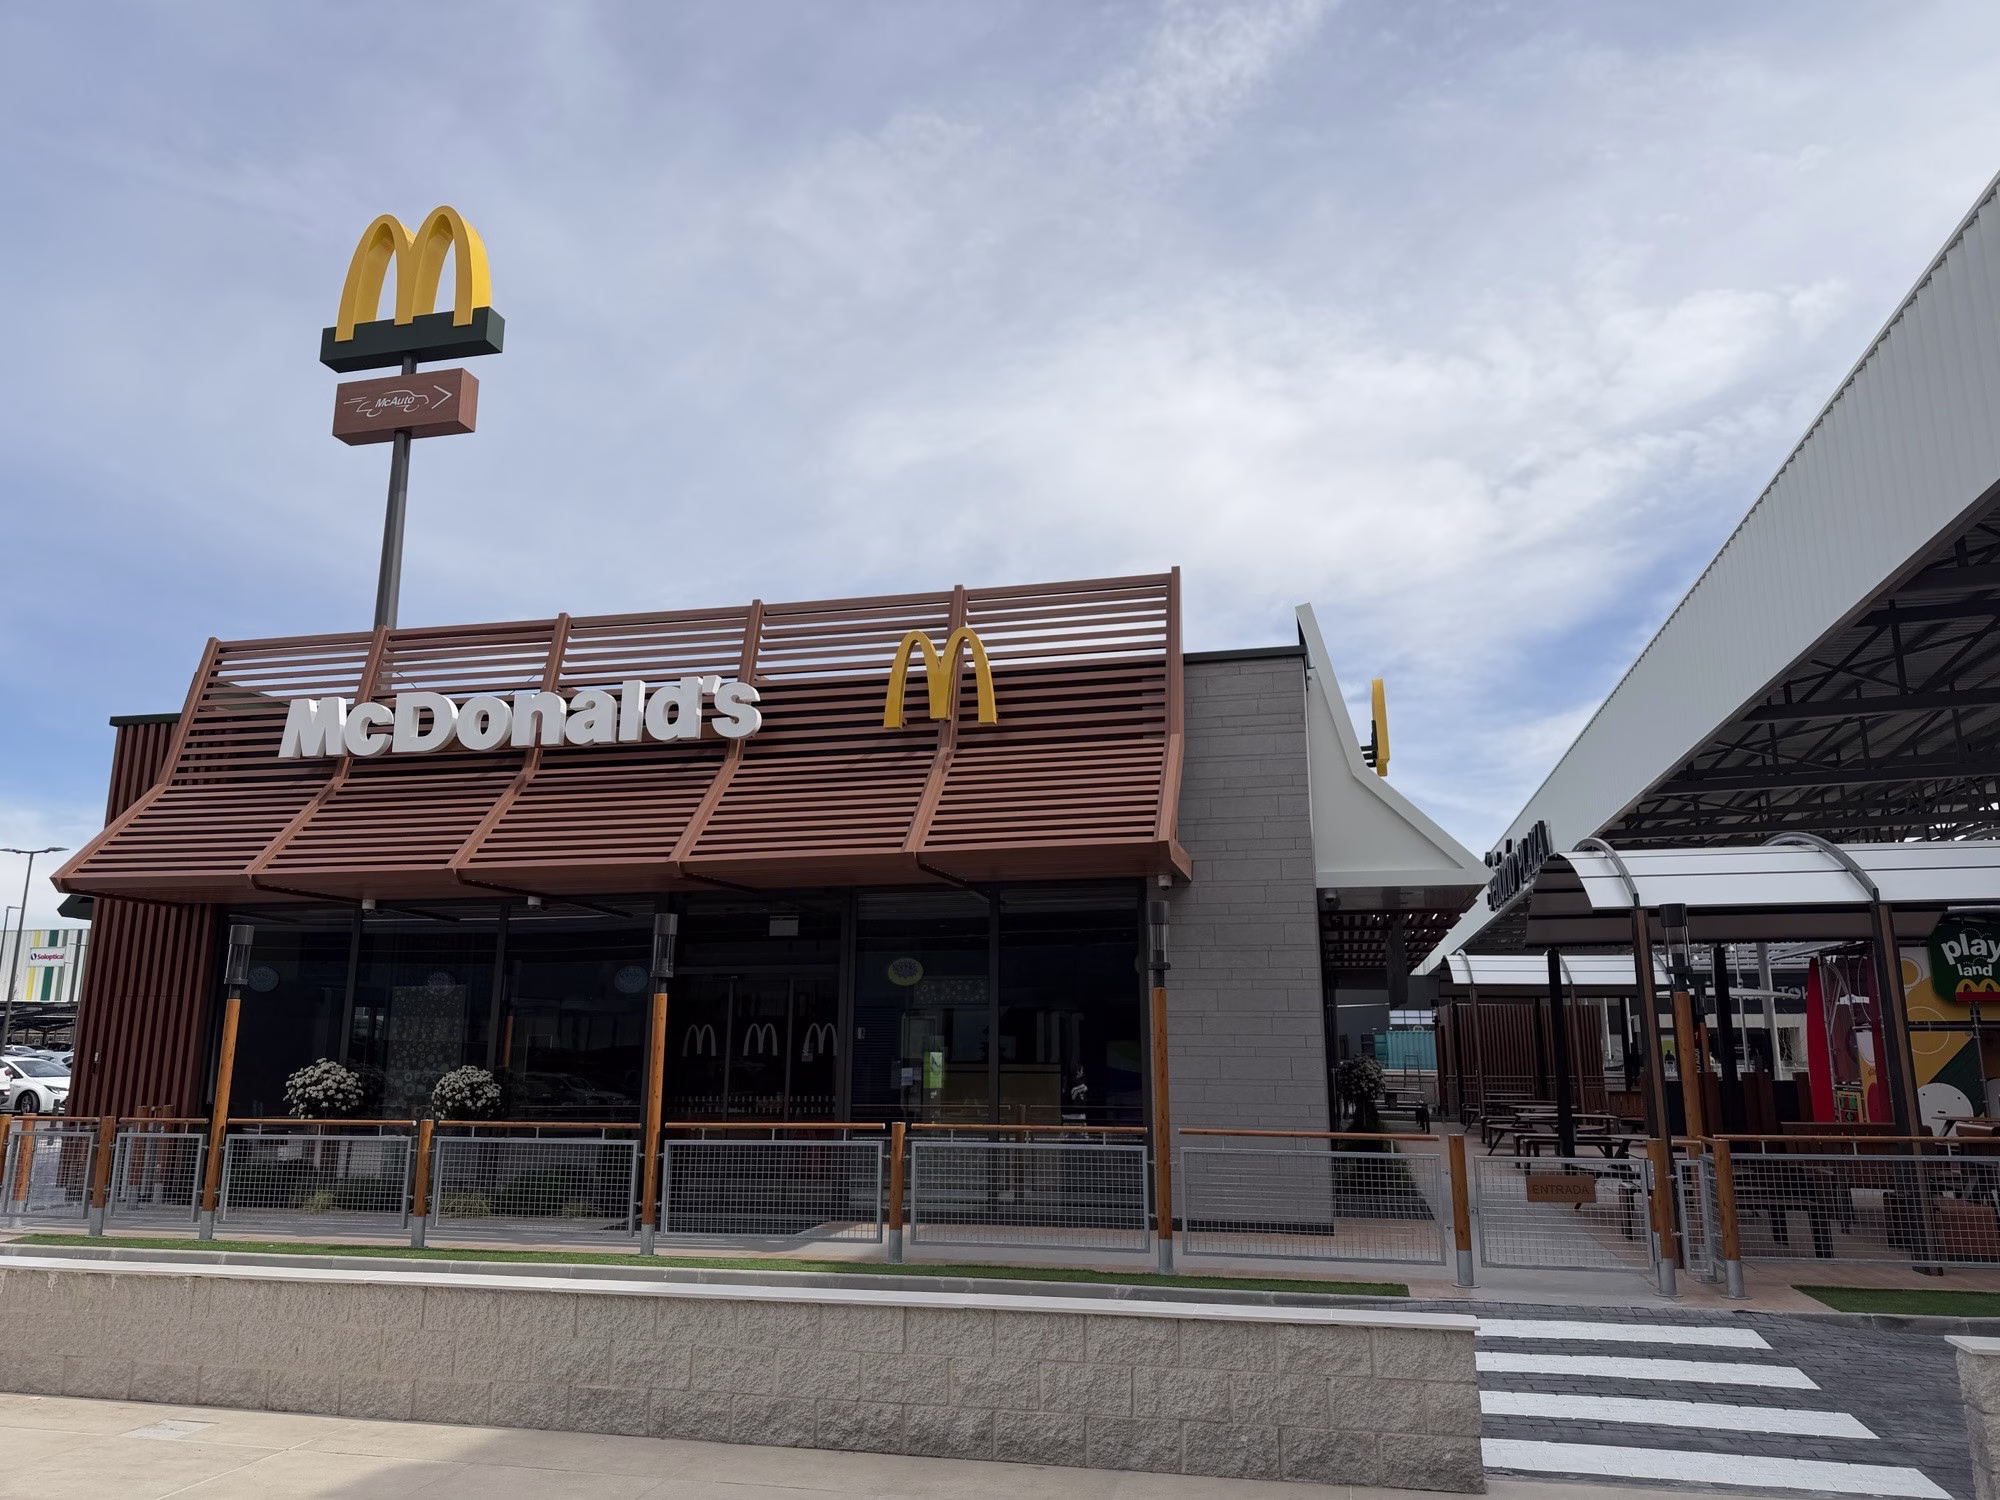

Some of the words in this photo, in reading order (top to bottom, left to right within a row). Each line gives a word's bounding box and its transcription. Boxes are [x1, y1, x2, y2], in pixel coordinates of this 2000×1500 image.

[375, 396, 415, 408] McAuto
[278, 674, 763, 759] McDonald's
[1940, 933, 2000, 964] play
[37, 953, 64, 961] Soloptical
[1956, 963, 1993, 976] land
[1532, 1184, 1590, 1195] ENTRADA
